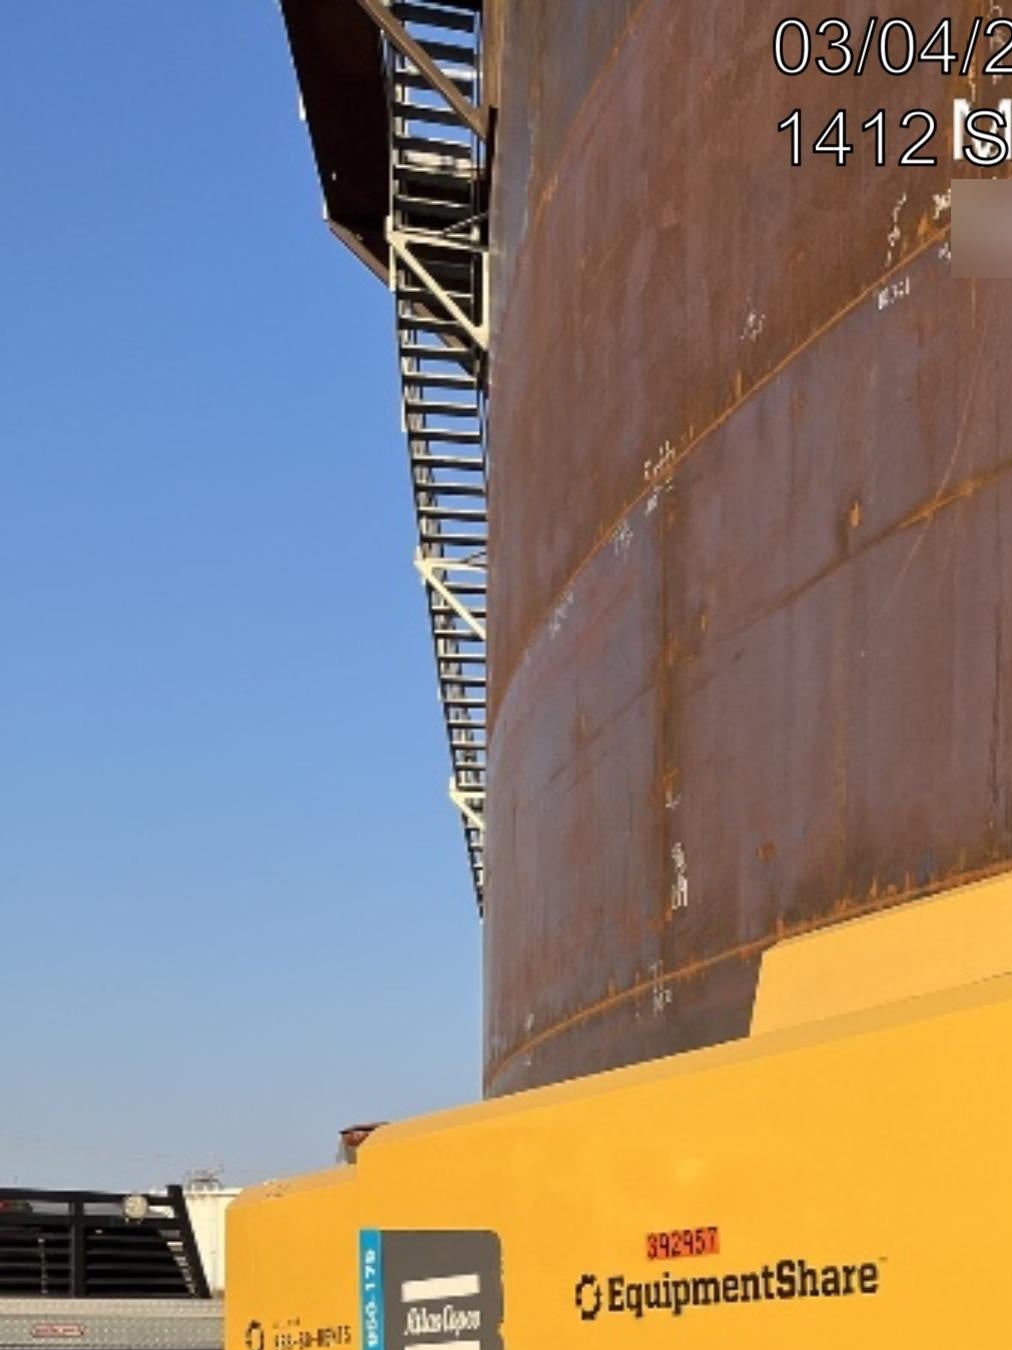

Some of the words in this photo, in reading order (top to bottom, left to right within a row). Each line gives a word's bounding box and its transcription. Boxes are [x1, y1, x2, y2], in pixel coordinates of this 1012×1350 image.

[647, 1226, 718, 1260] 392957
[607, 1259, 878, 1318] EquipmentShare
[404, 1307, 441, 1336] Atlas
[443, 1303, 481, 1338] Copco
